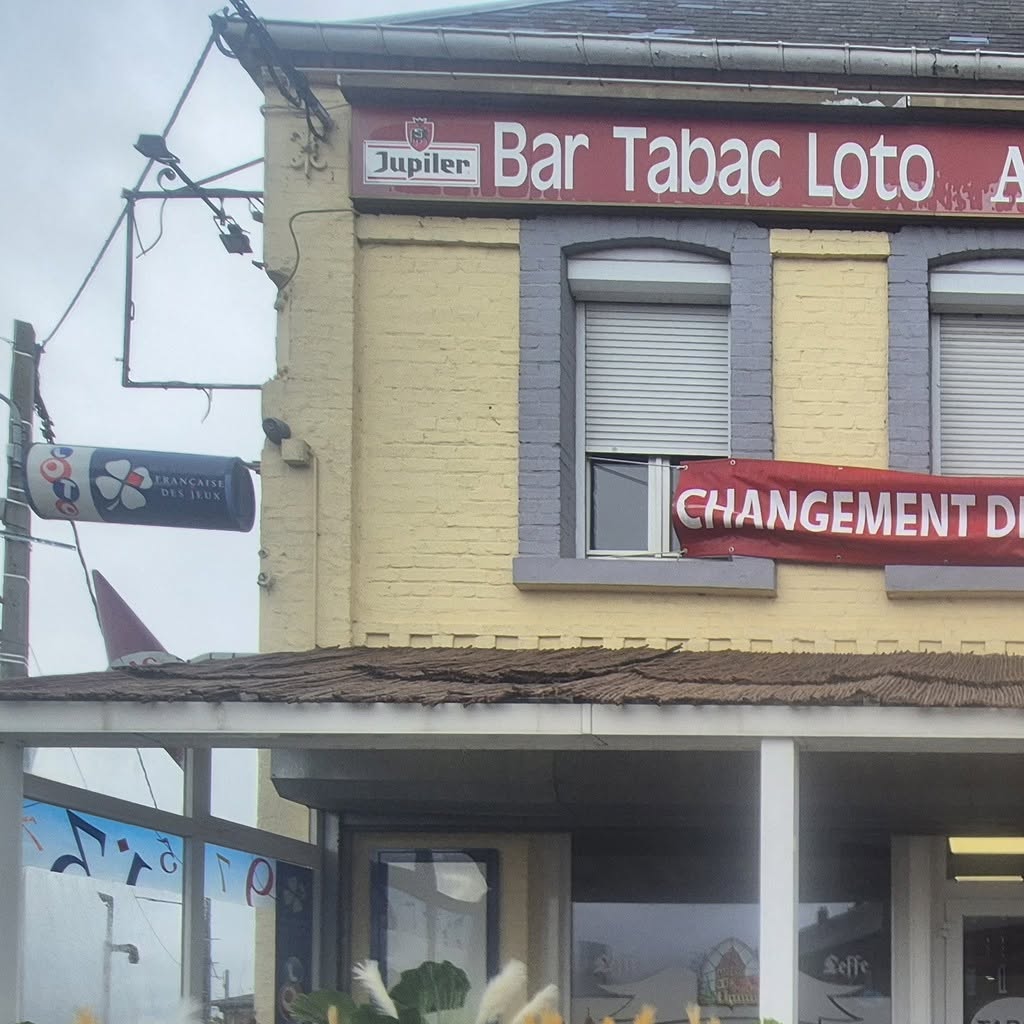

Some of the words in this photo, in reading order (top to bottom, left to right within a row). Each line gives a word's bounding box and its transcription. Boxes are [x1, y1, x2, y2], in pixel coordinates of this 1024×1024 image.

[375, 151, 471, 181] Jupiler
[494, 122, 589, 190] Bar
[612, 126, 782, 197] Tabac
[808, 131, 936, 202] Loto
[155, 475, 225, 488] FRANÇAISE
[161, 488, 184, 497] DES
[191, 490, 221, 501] JEUX
[675, 488, 976, 538] CHANGEMENT
